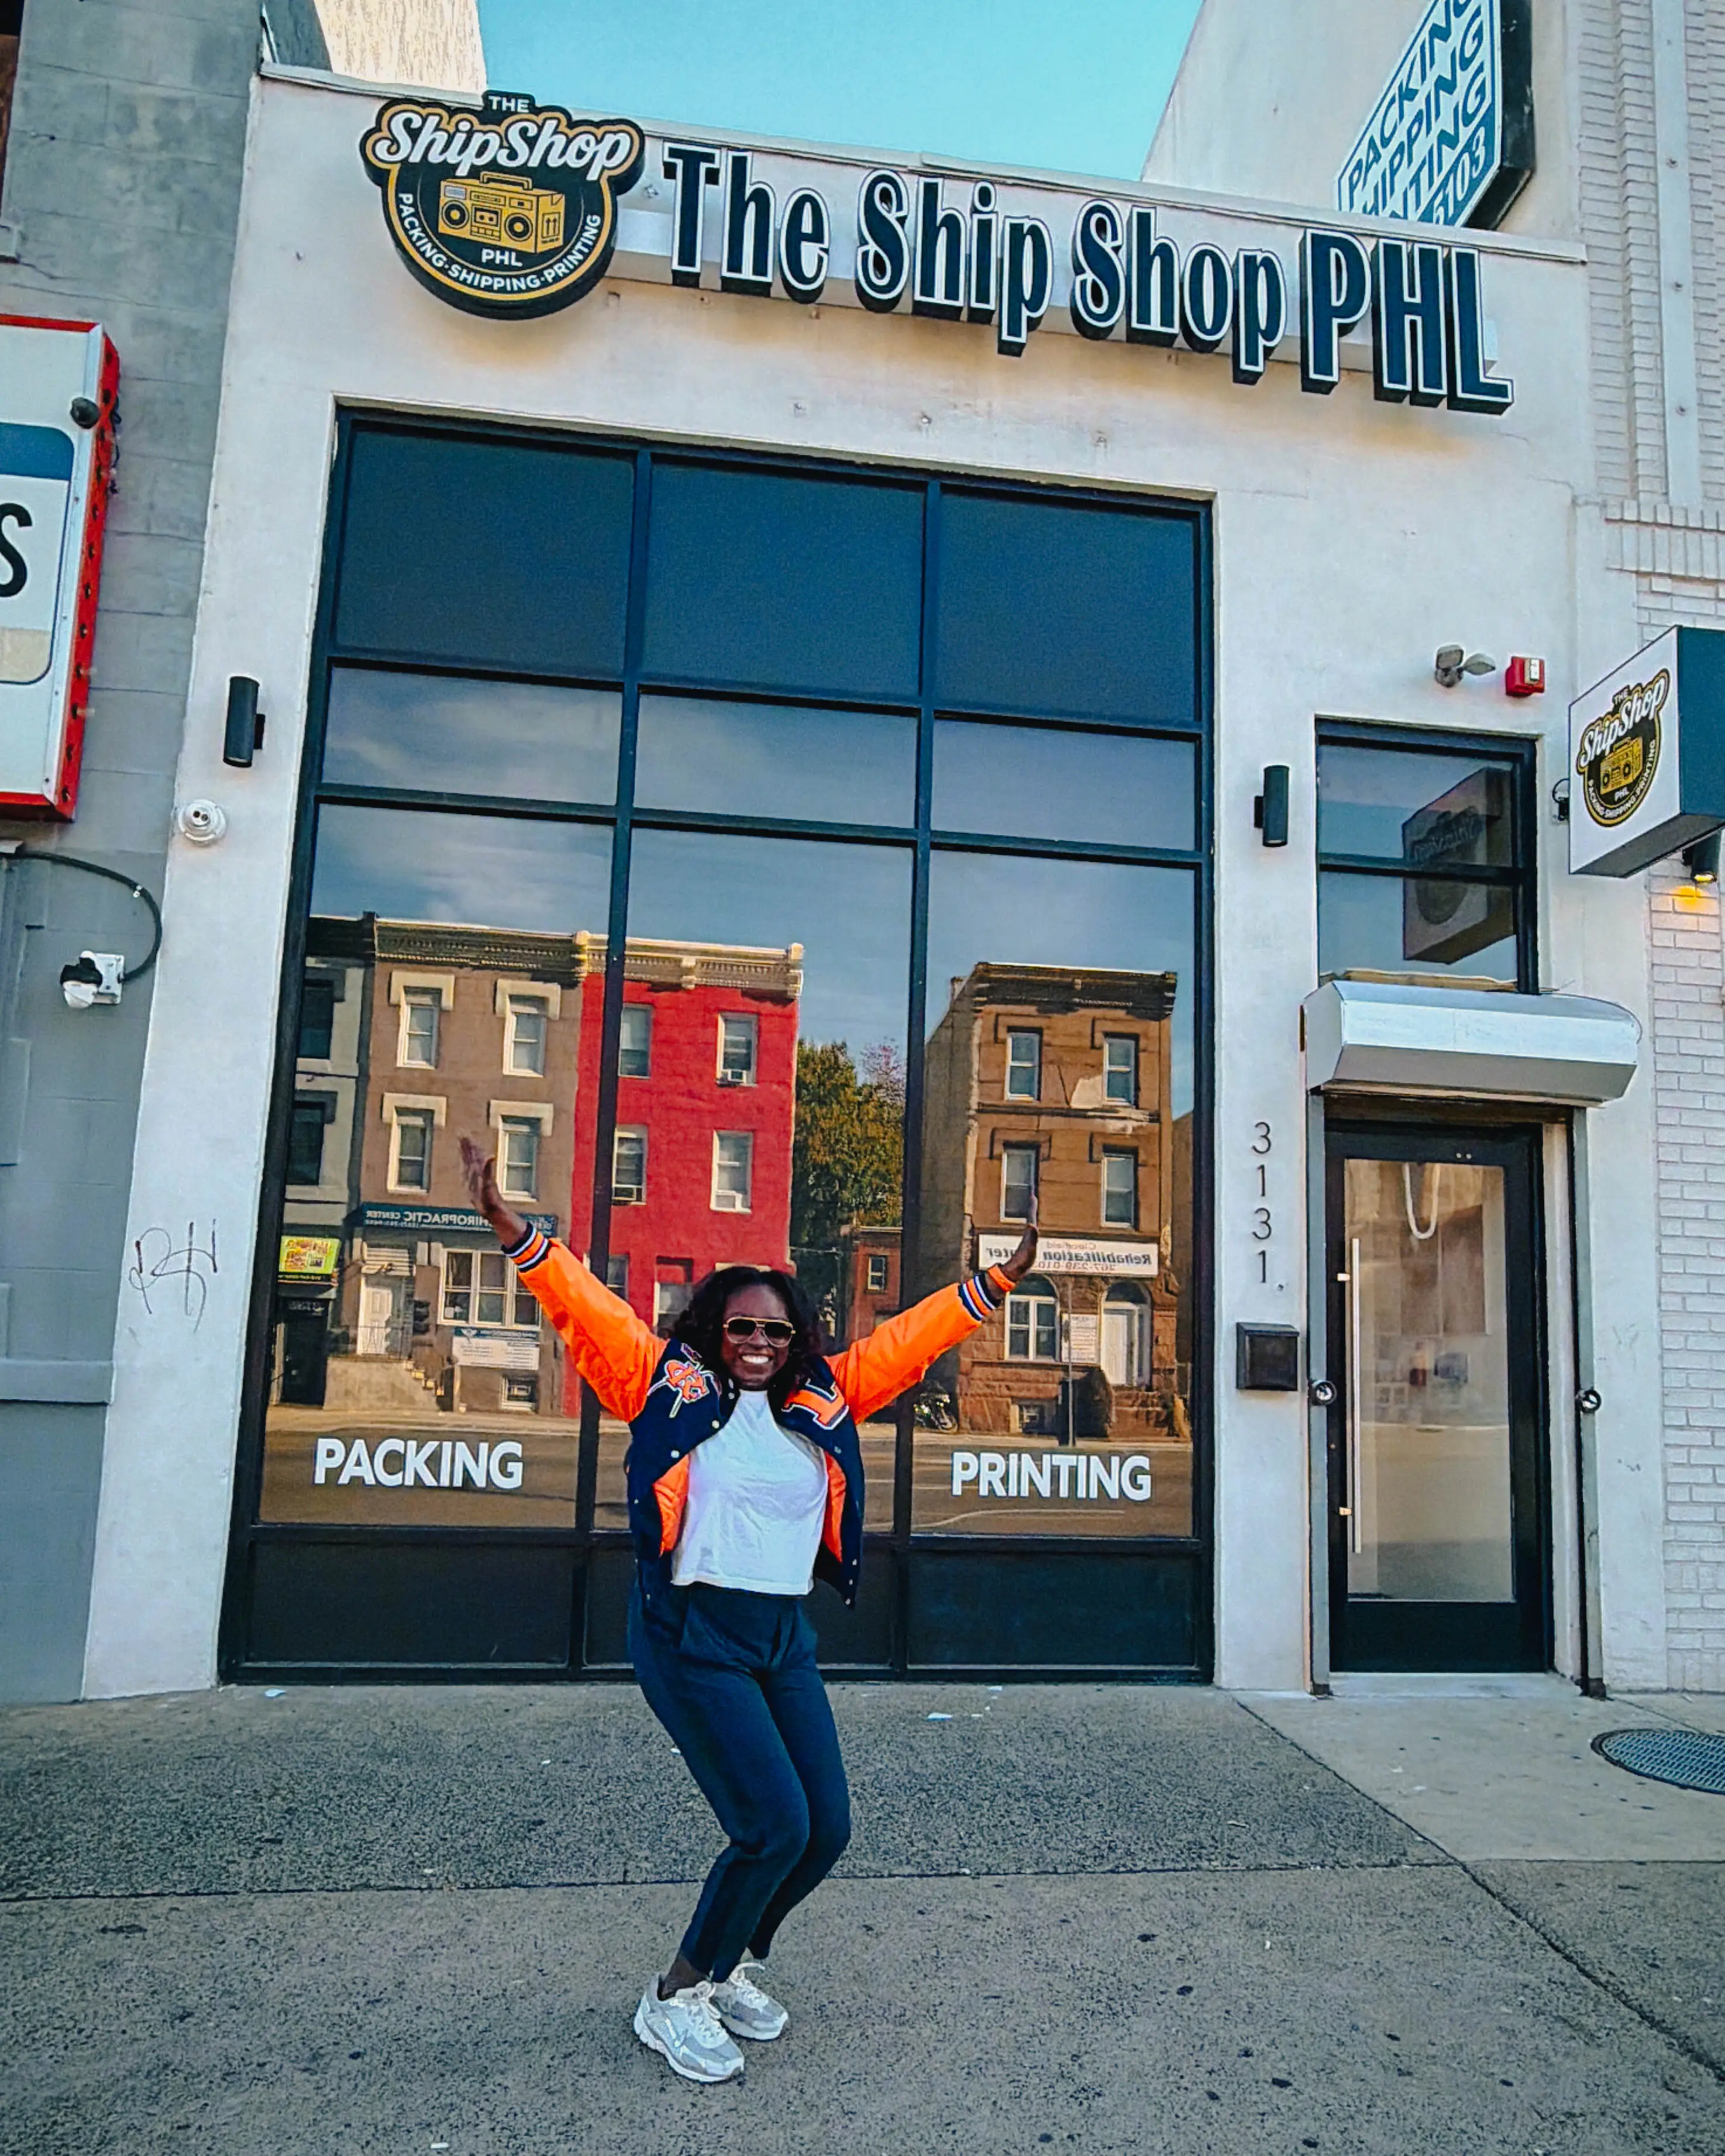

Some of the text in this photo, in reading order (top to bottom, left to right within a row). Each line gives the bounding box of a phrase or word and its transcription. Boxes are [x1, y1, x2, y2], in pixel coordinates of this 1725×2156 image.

[488, 95, 530, 113] THE
[1362, 4, 1483, 216] HIPPING
[372, 112, 631, 181] ShipShop
[1389, 60, 1486, 220] NTING
[398, 192, 601, 291] PACKING SHIPPING PRINTING
[481, 247, 523, 267] PHL
[663, 142, 1513, 404] The Ship Shop PHL
[1614, 689, 1628, 705] THE
[1252, 1121, 1272, 1283] 3131
[314, 1438, 523, 1489] PACKING
[951, 1451, 1152, 1501] PRINTING
